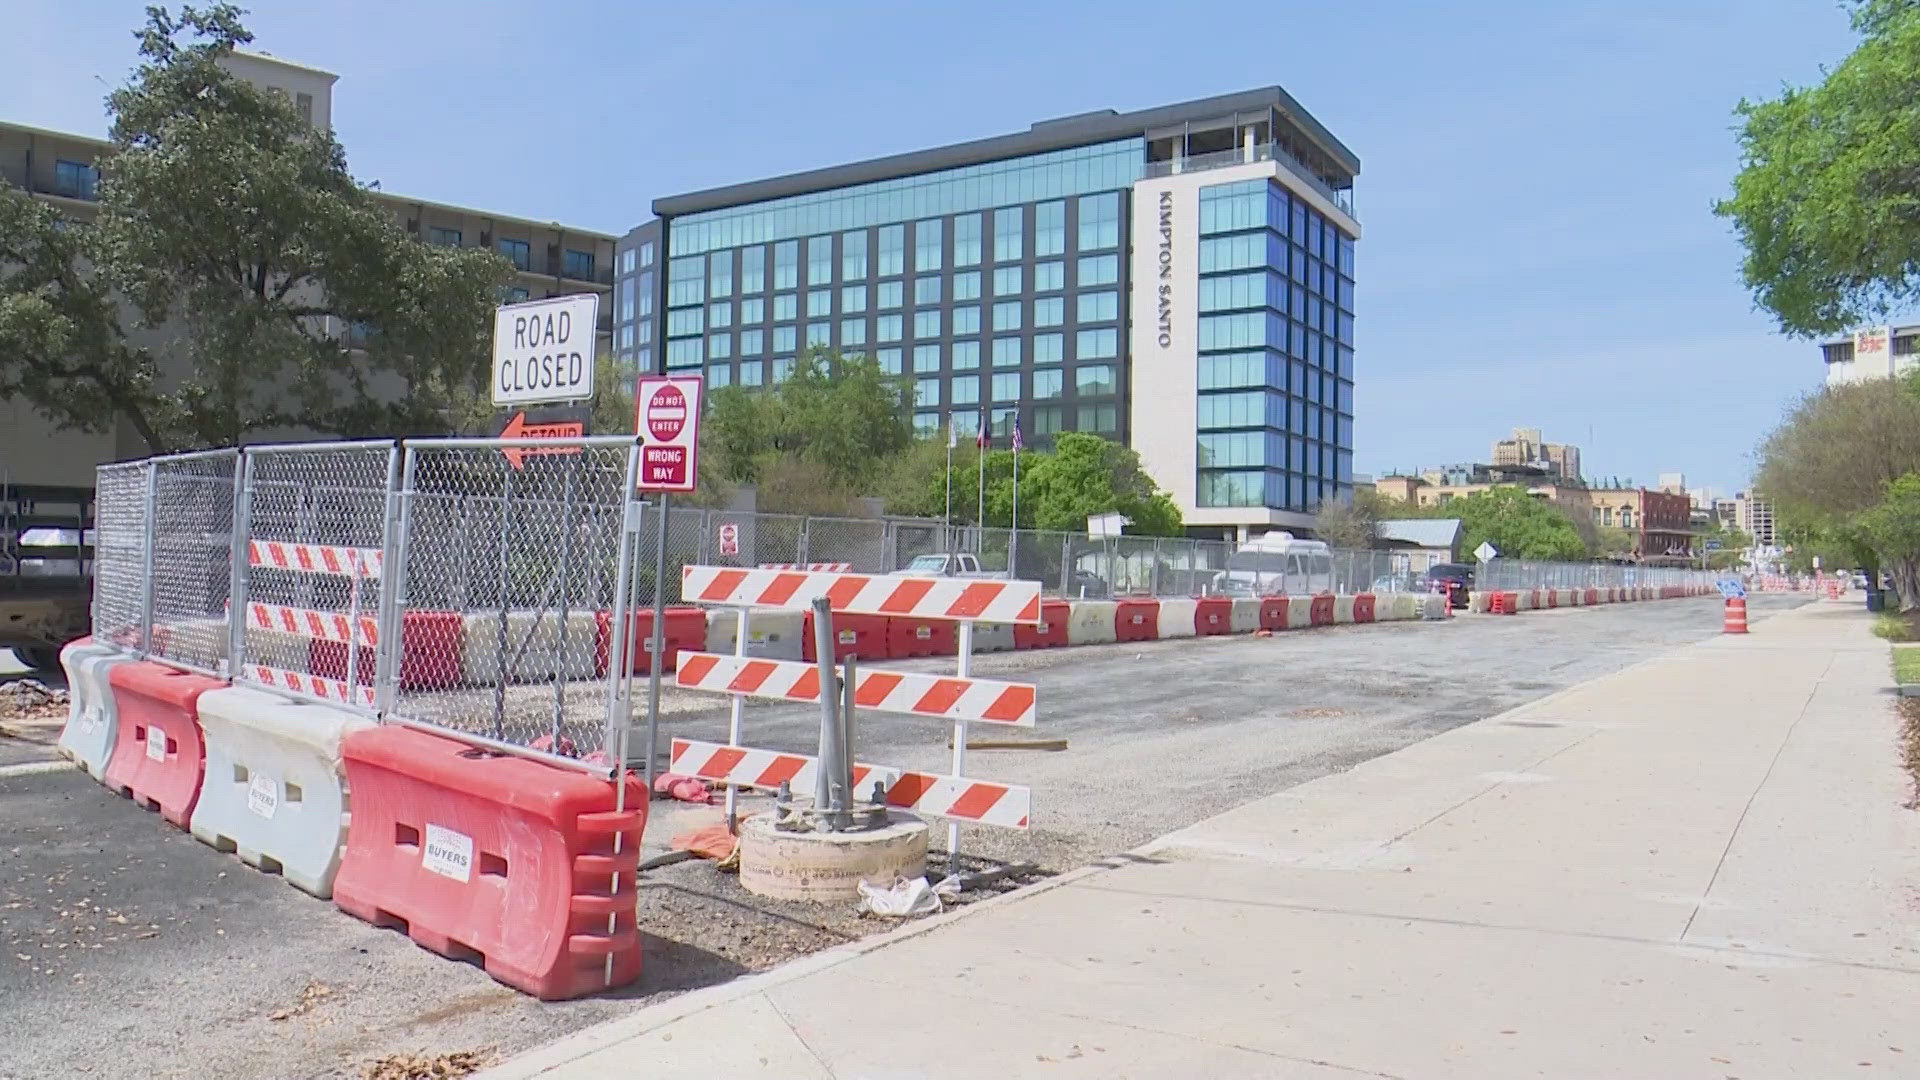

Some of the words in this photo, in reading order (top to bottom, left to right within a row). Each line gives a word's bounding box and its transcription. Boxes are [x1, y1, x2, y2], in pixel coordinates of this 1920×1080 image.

[1159, 191, 1173, 280] KIMPTON
[1158, 284, 1172, 349] SANTO
[514, 310, 571, 349] ROAD
[501, 352, 583, 392] CLOSED
[652, 396, 664, 406] DO
[665, 395, 683, 406] NOT
[651, 421, 679, 432] ENTER
[647, 450, 682, 463] WRONG
[653, 467, 674, 480] WAY
[428, 843, 468, 866] BUYERS
